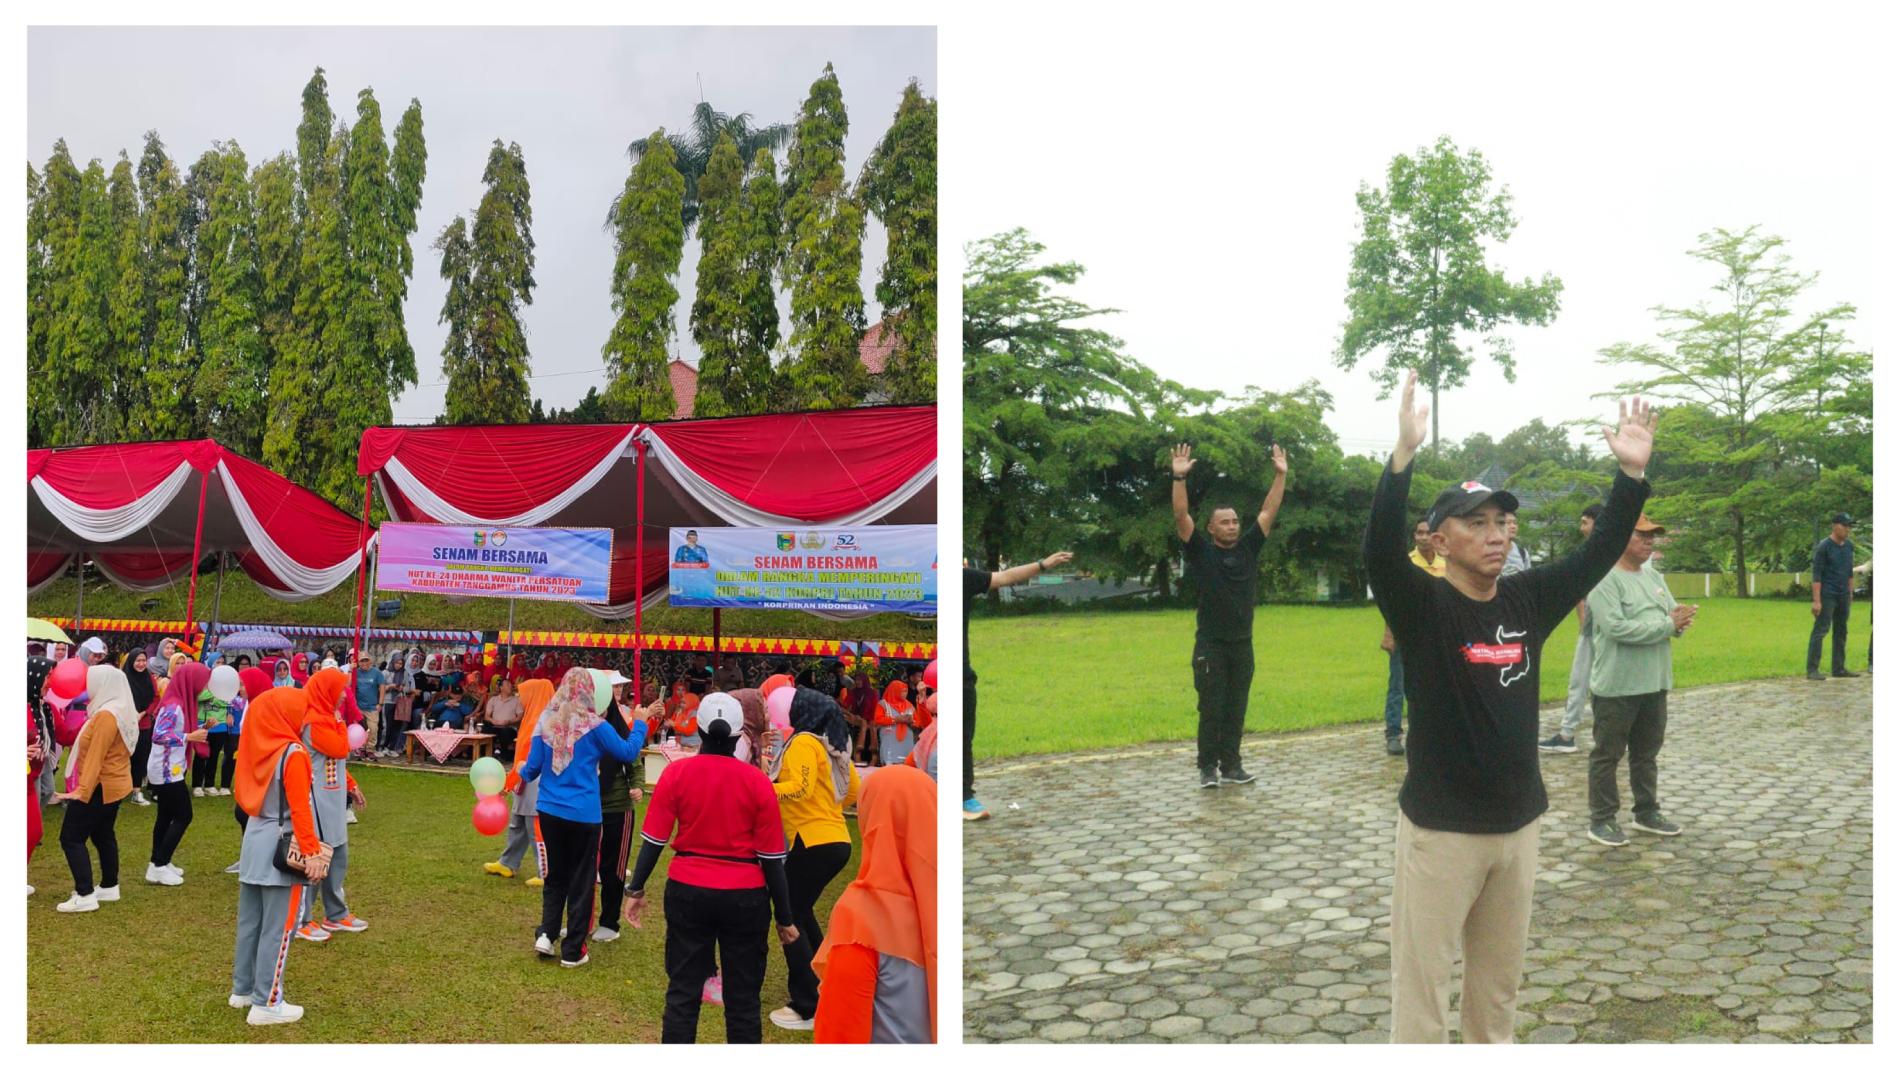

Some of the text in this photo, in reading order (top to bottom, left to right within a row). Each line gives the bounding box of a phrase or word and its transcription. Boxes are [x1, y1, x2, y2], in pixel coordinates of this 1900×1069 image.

[433, 547, 548, 564] SENAM BERSAMA
[754, 556, 878, 569] SENAM BERSAMA
[408, 569, 424, 578] HUT
[452, 572, 489, 582] DHARMA
[492, 574, 526, 584] WANITA
[528, 576, 582, 587] PERSATUAN
[762, 571, 814, 583] RANGKA
[818, 572, 922, 584] MEMPERINGATI
[412, 578, 577, 595] KABUPATEN TANGGAMUS TAHUN 2023
[837, 587, 882, 600] TAHUN
